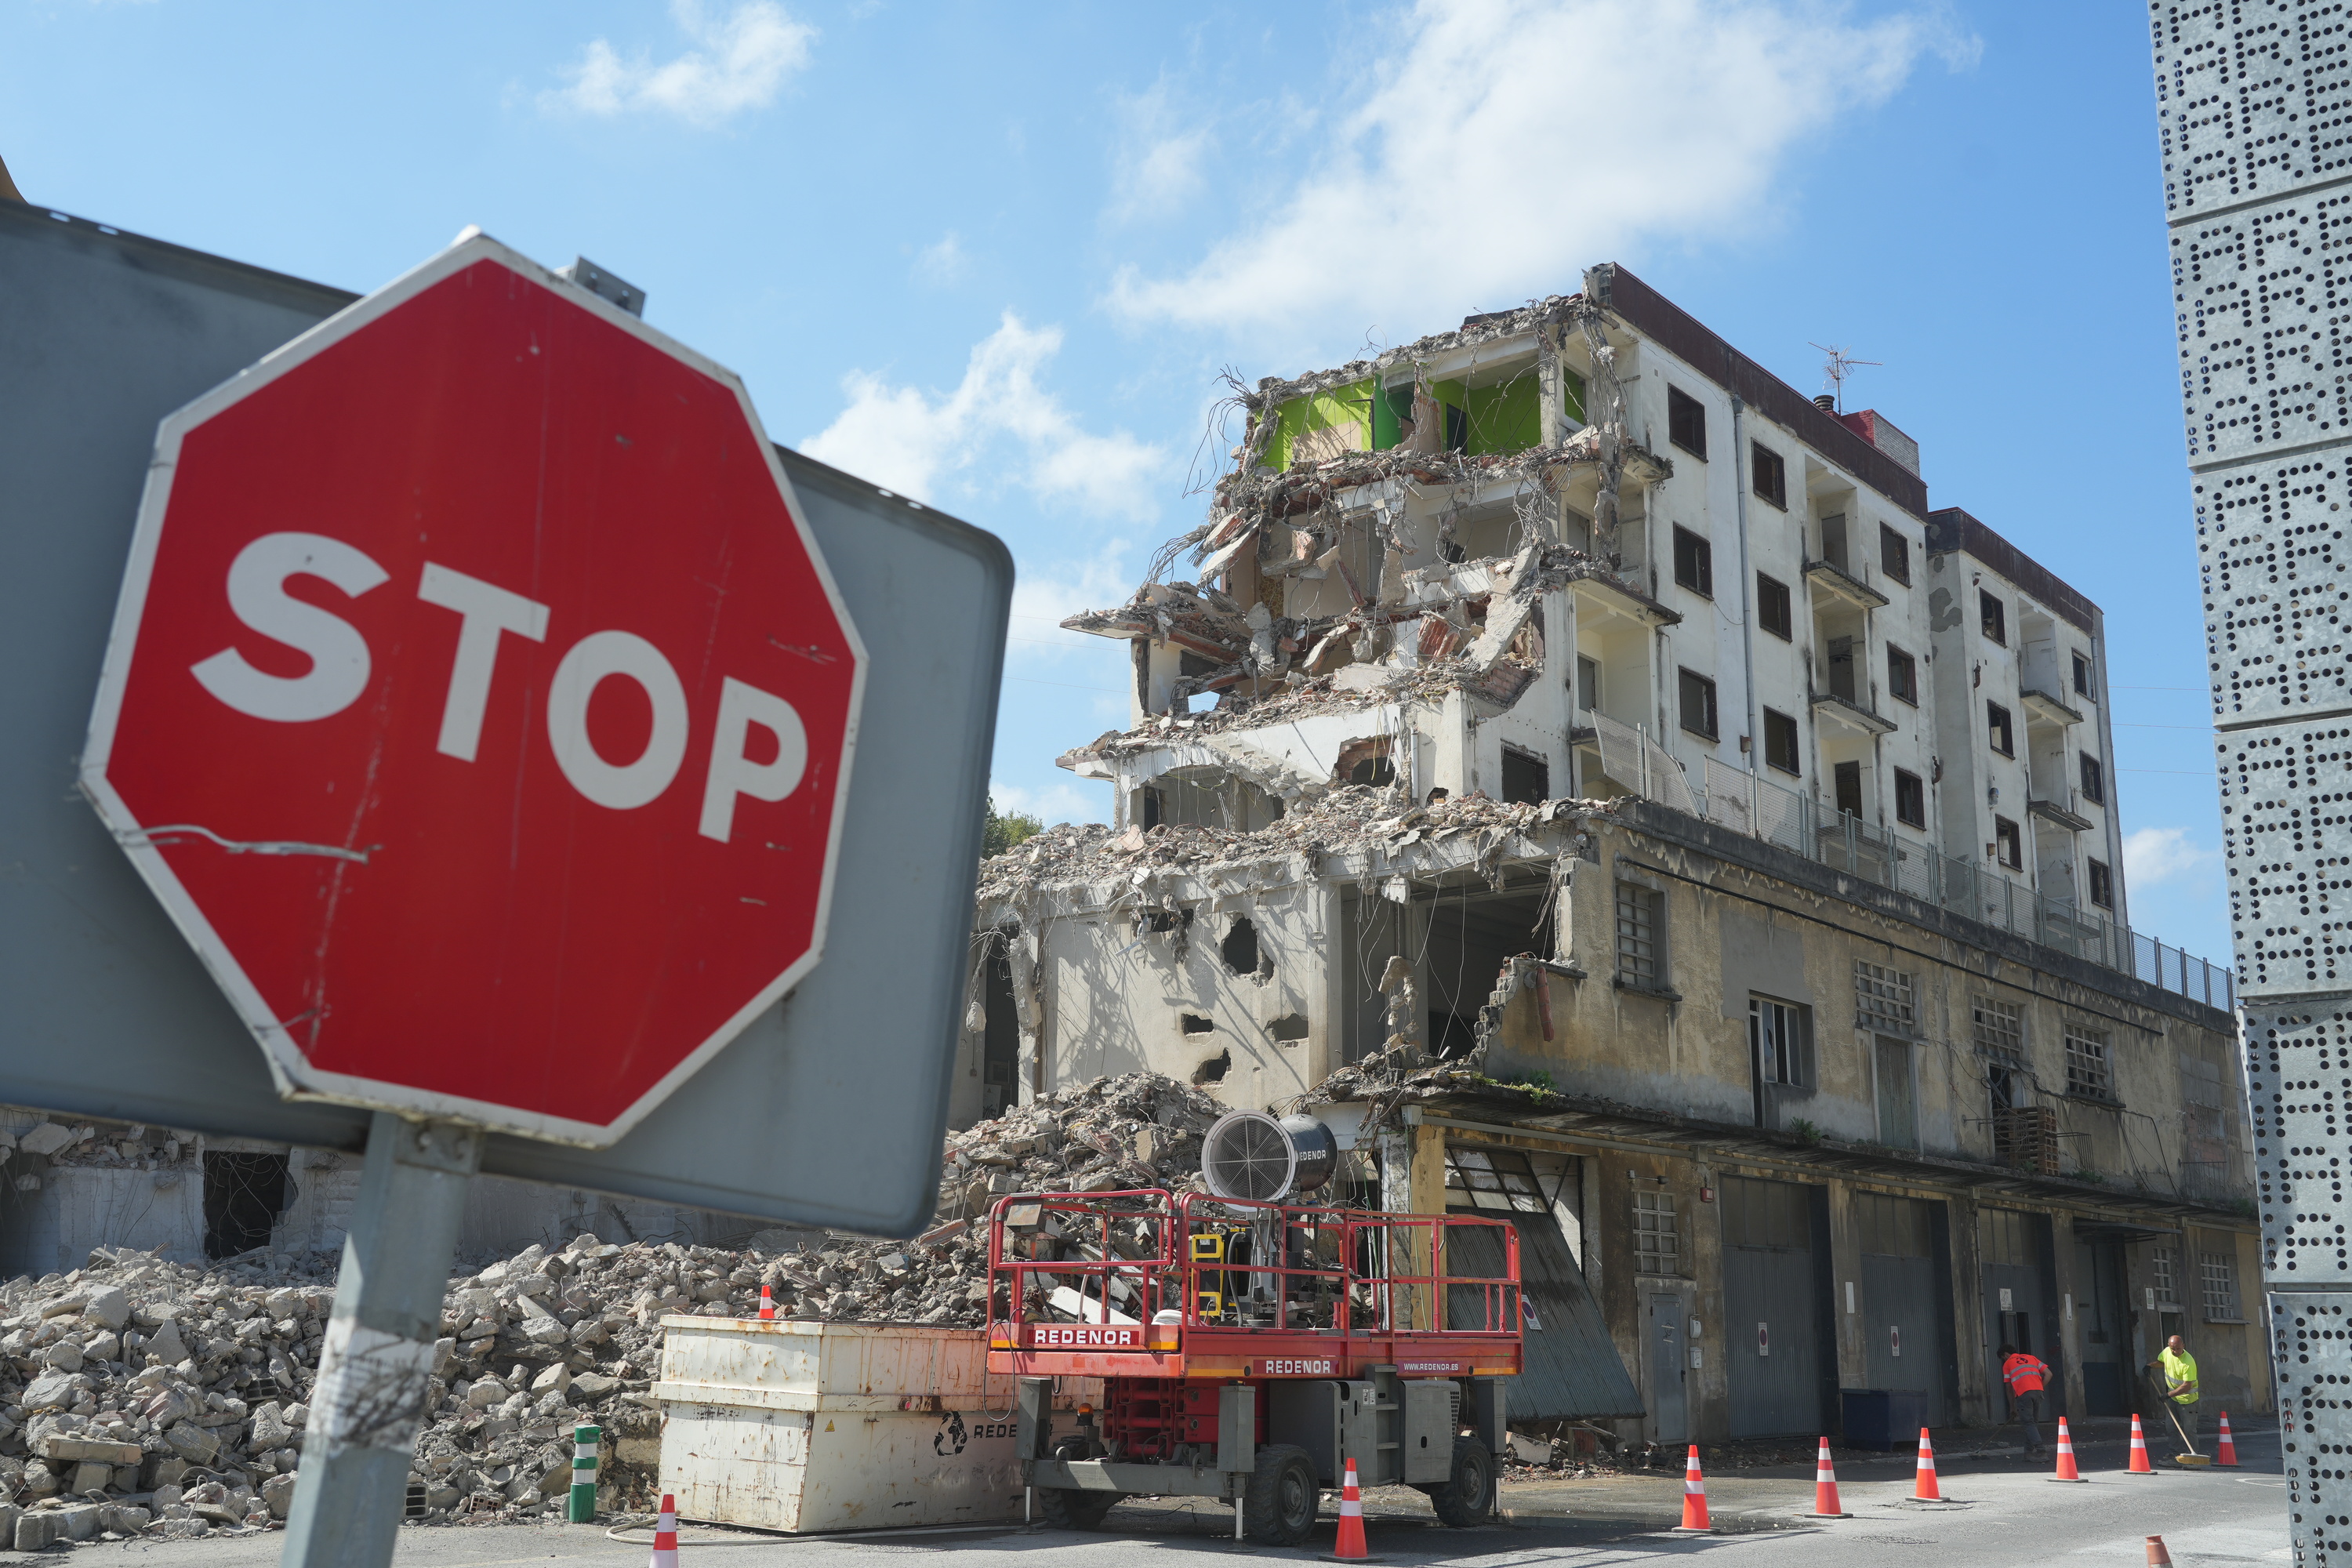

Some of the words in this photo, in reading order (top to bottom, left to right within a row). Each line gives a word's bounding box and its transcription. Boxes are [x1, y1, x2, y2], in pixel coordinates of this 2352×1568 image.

[190, 532, 808, 842] STOP
[1035, 1330, 1131, 1345] REDENOR
[1266, 1360, 1330, 1374] REDENOR
